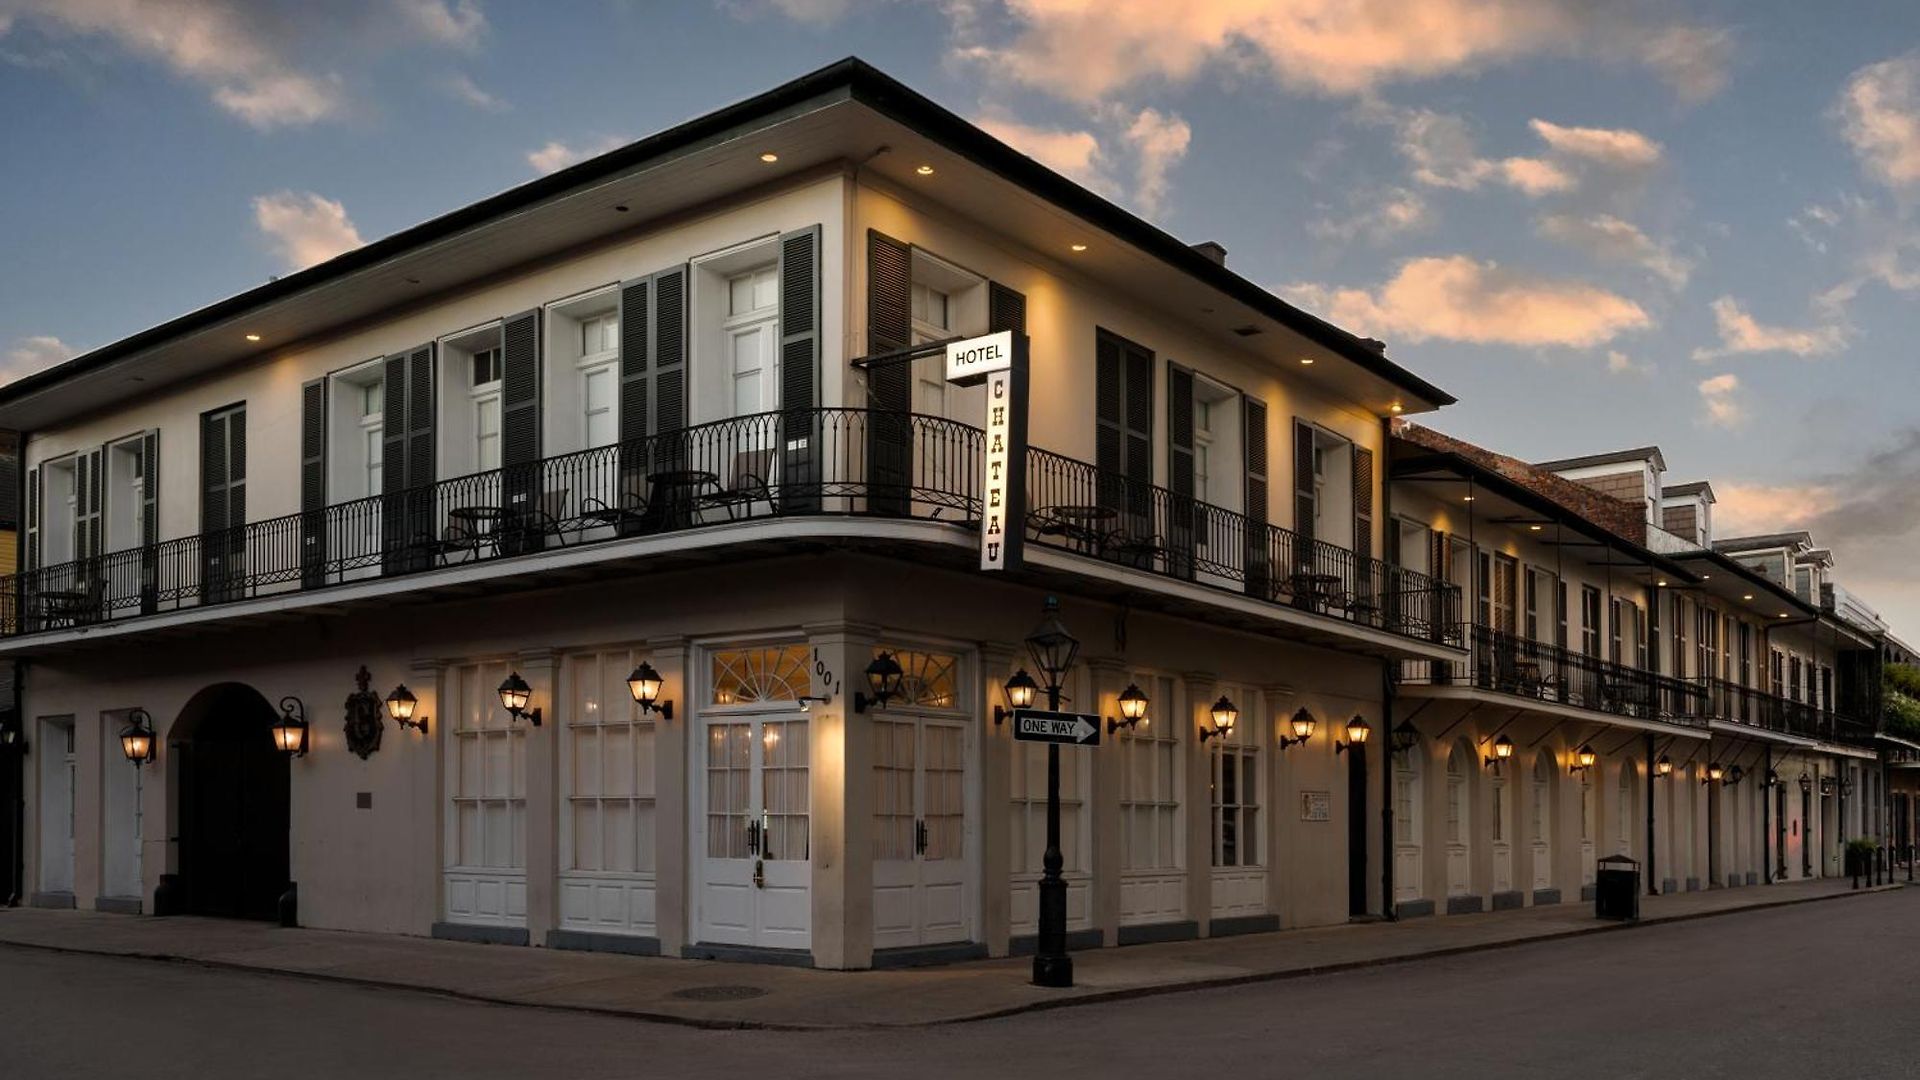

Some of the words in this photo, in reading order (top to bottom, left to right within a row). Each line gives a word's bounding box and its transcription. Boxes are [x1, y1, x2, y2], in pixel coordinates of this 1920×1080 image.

[956, 344, 1003, 366] HOTEL
[987, 380, 1005, 562] CHATEAU
[814, 647, 840, 695] 1001
[1023, 719, 1047, 733] ONE
[1051, 721, 1076, 735] WAY
